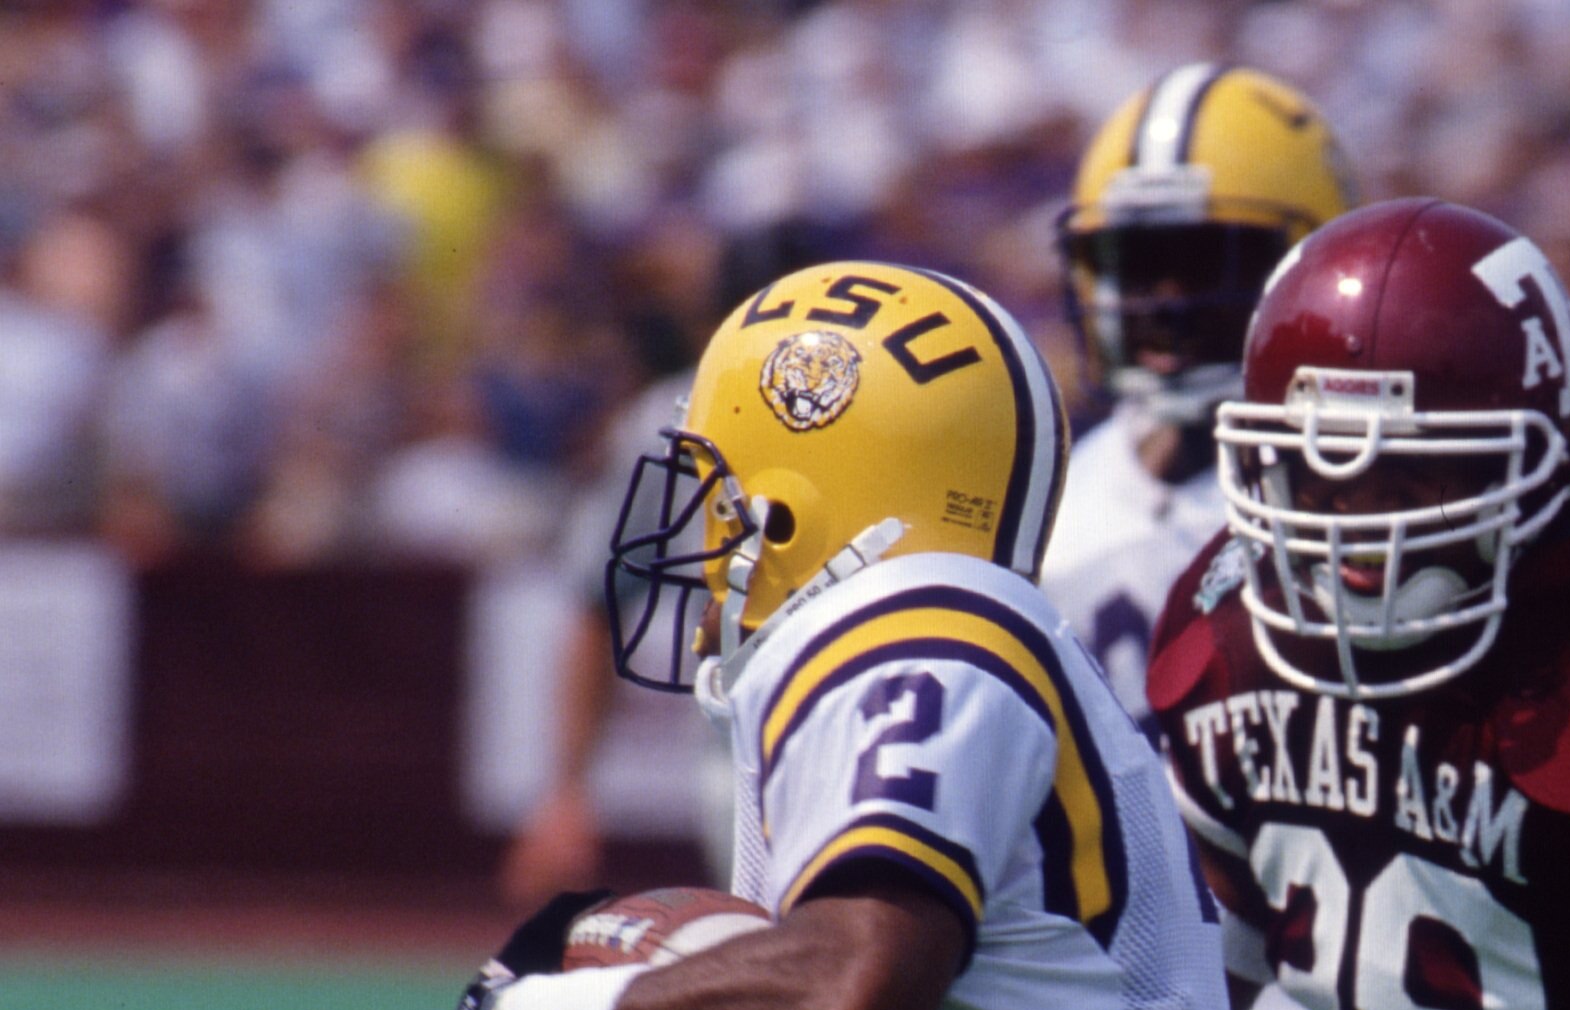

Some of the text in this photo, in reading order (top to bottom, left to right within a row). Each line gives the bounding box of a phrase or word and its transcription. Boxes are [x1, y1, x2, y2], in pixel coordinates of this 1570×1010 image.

[740, 275, 983, 385] LSU
[851, 669, 947, 812] 2
[1185, 690, 1529, 885] TEXAS A&M
